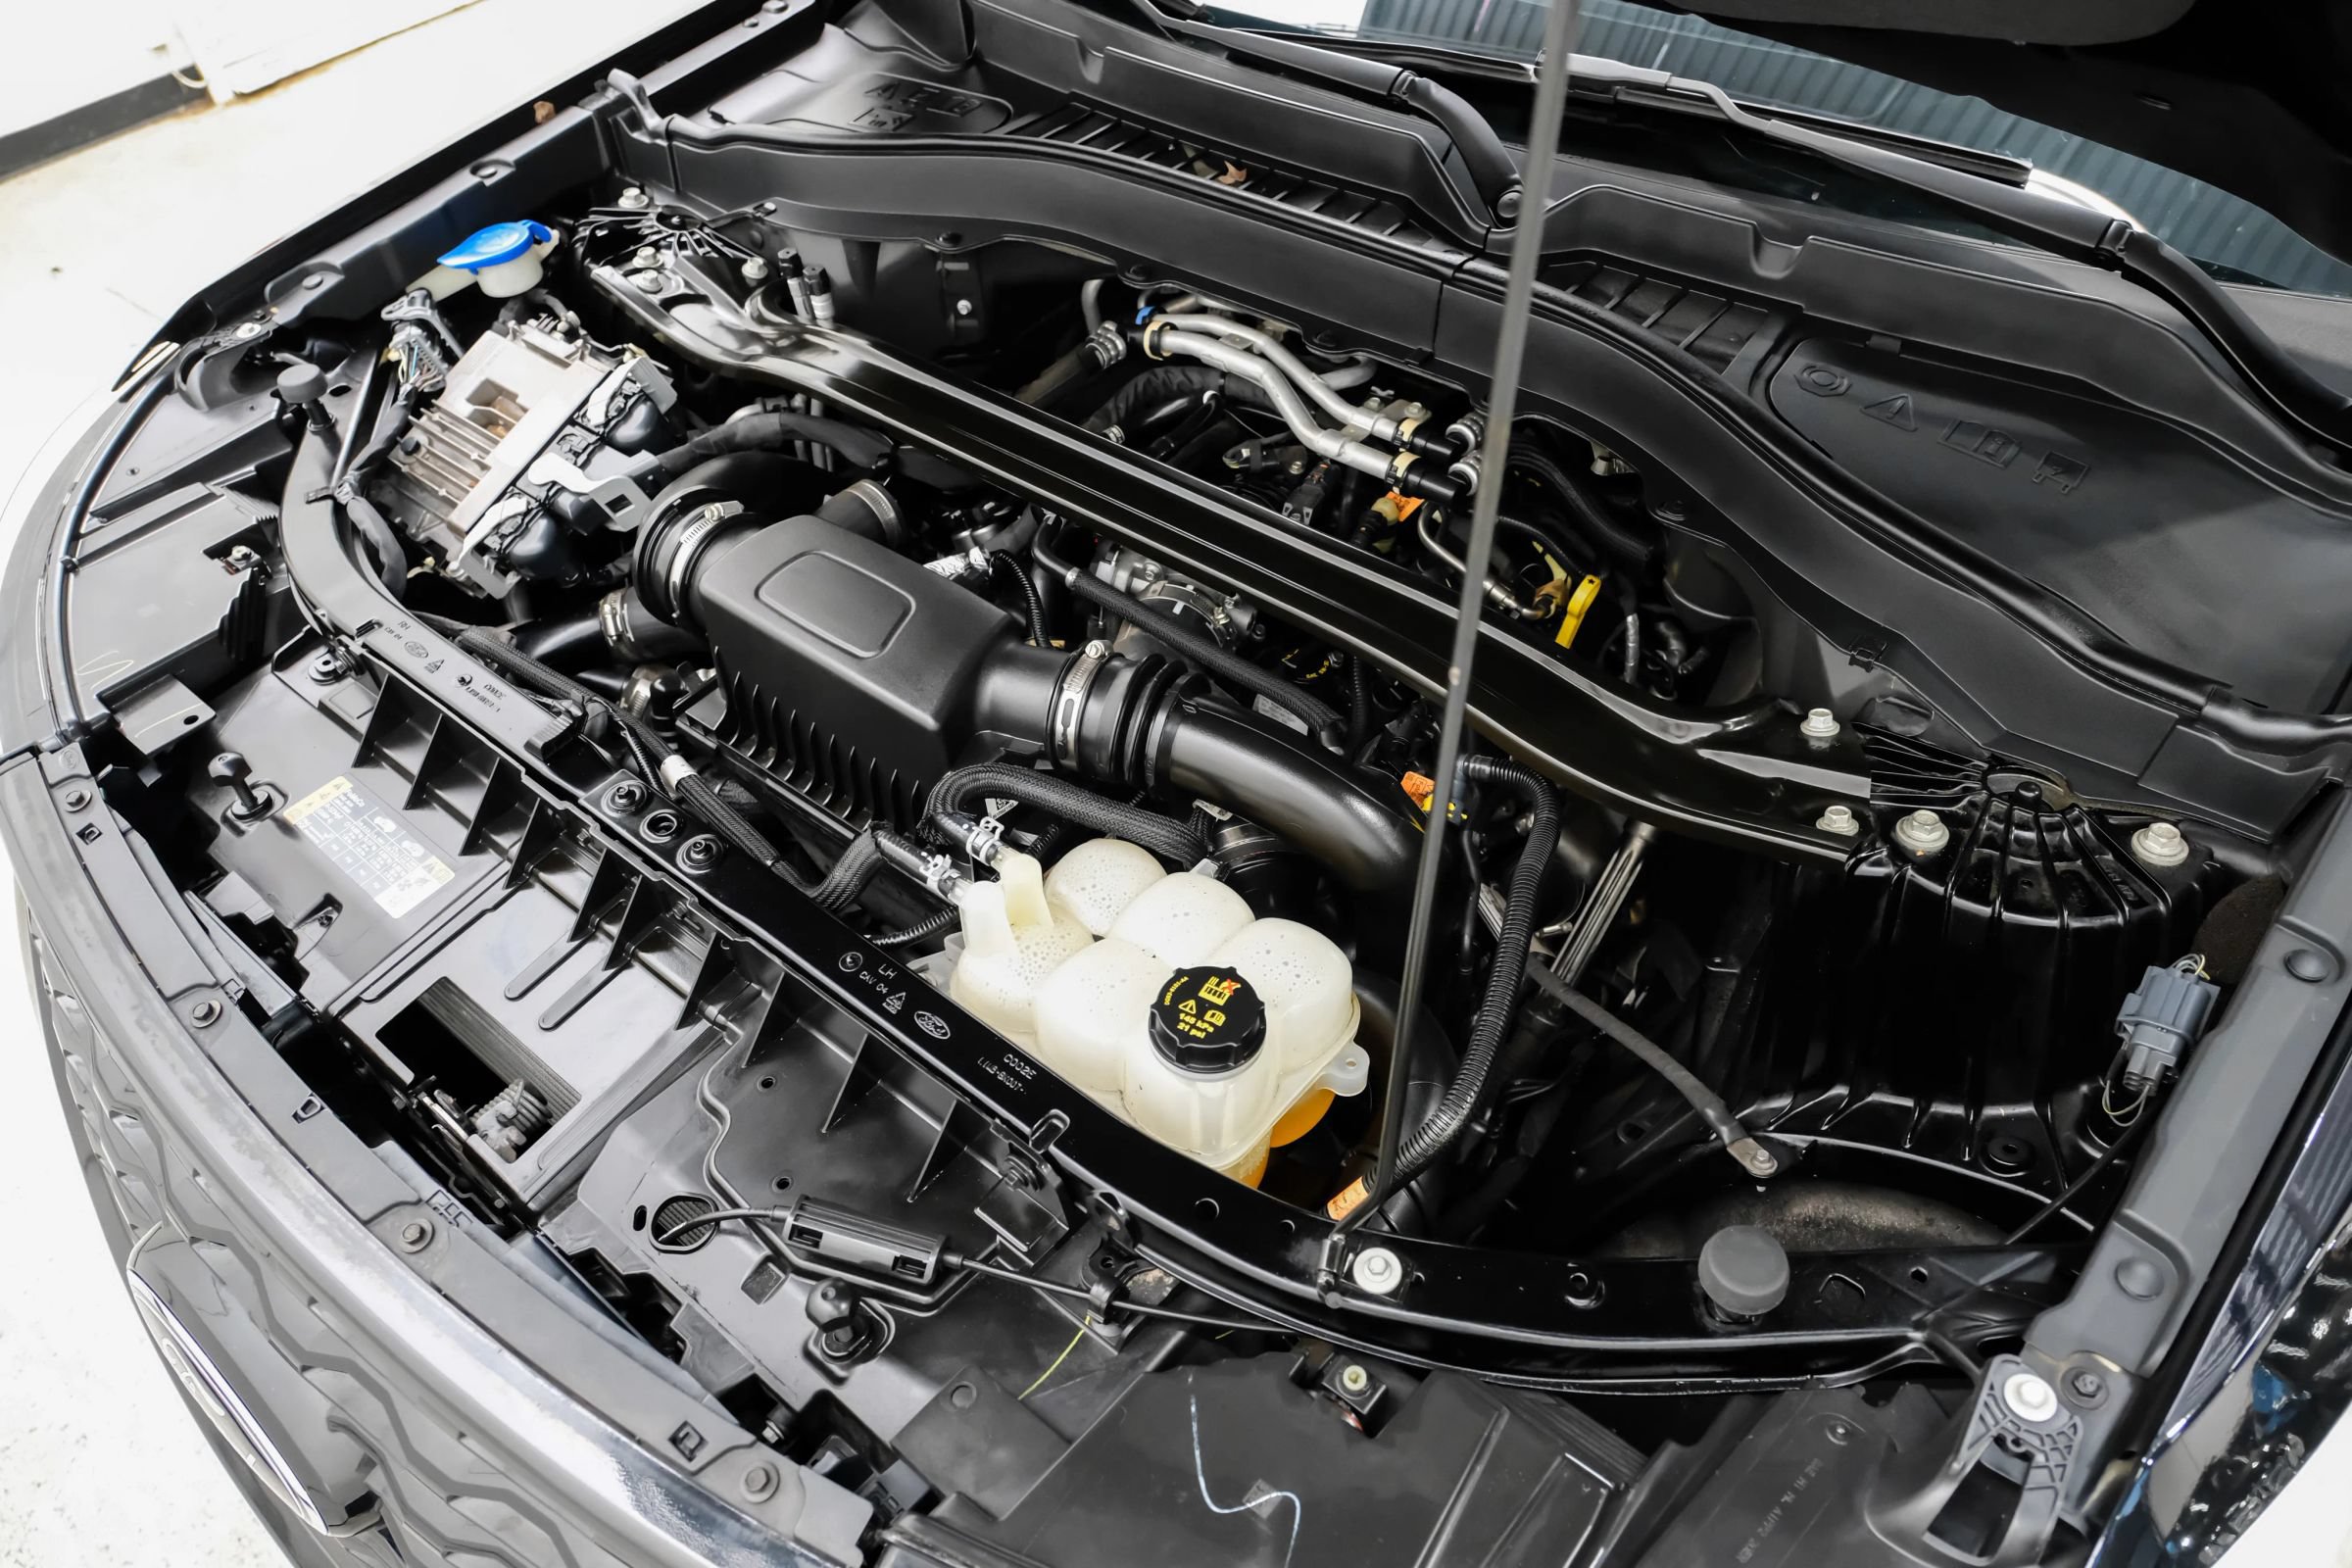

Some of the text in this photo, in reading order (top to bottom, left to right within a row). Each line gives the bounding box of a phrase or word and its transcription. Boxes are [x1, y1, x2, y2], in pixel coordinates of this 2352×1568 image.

[877, 963, 898, 979] LH
[858, 970, 890, 995] CAV 04
[916, 1012, 949, 1037] Ford
[1177, 1022, 1206, 1039] 21 psi
[1179, 1012, 1214, 1033] 145 kPa
